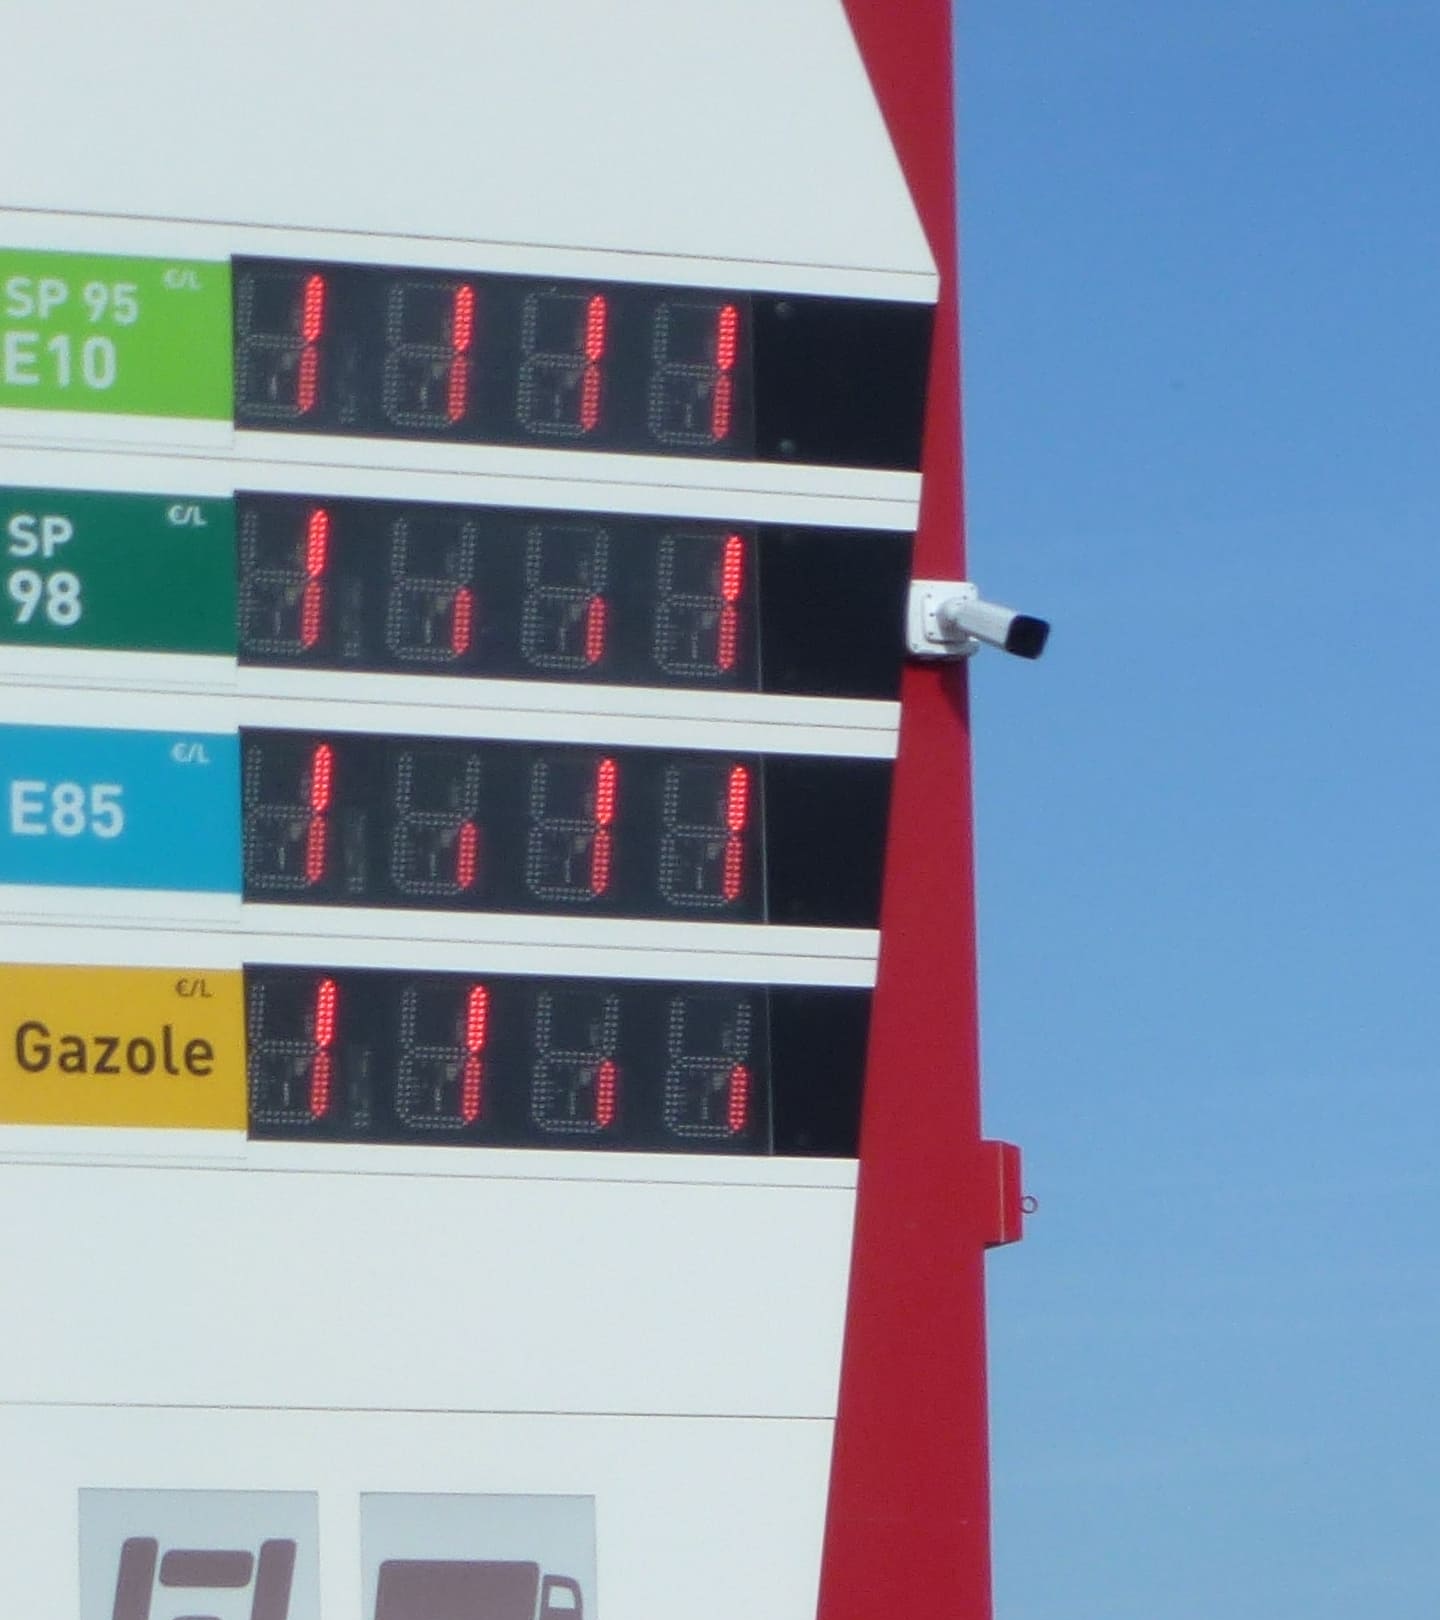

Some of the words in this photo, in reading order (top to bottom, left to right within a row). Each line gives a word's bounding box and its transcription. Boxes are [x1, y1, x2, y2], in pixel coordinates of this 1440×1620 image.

[5, 275, 69, 321] SP
[82, 280, 140, 327] 95
[4, 330, 117, 390] E10
[8, 513, 74, 558] SP
[8, 568, 82, 626] 98
[10, 779, 125, 838] E85
[174, 977, 215, 999] €/L
[15, 1019, 215, 1077] Gazole
